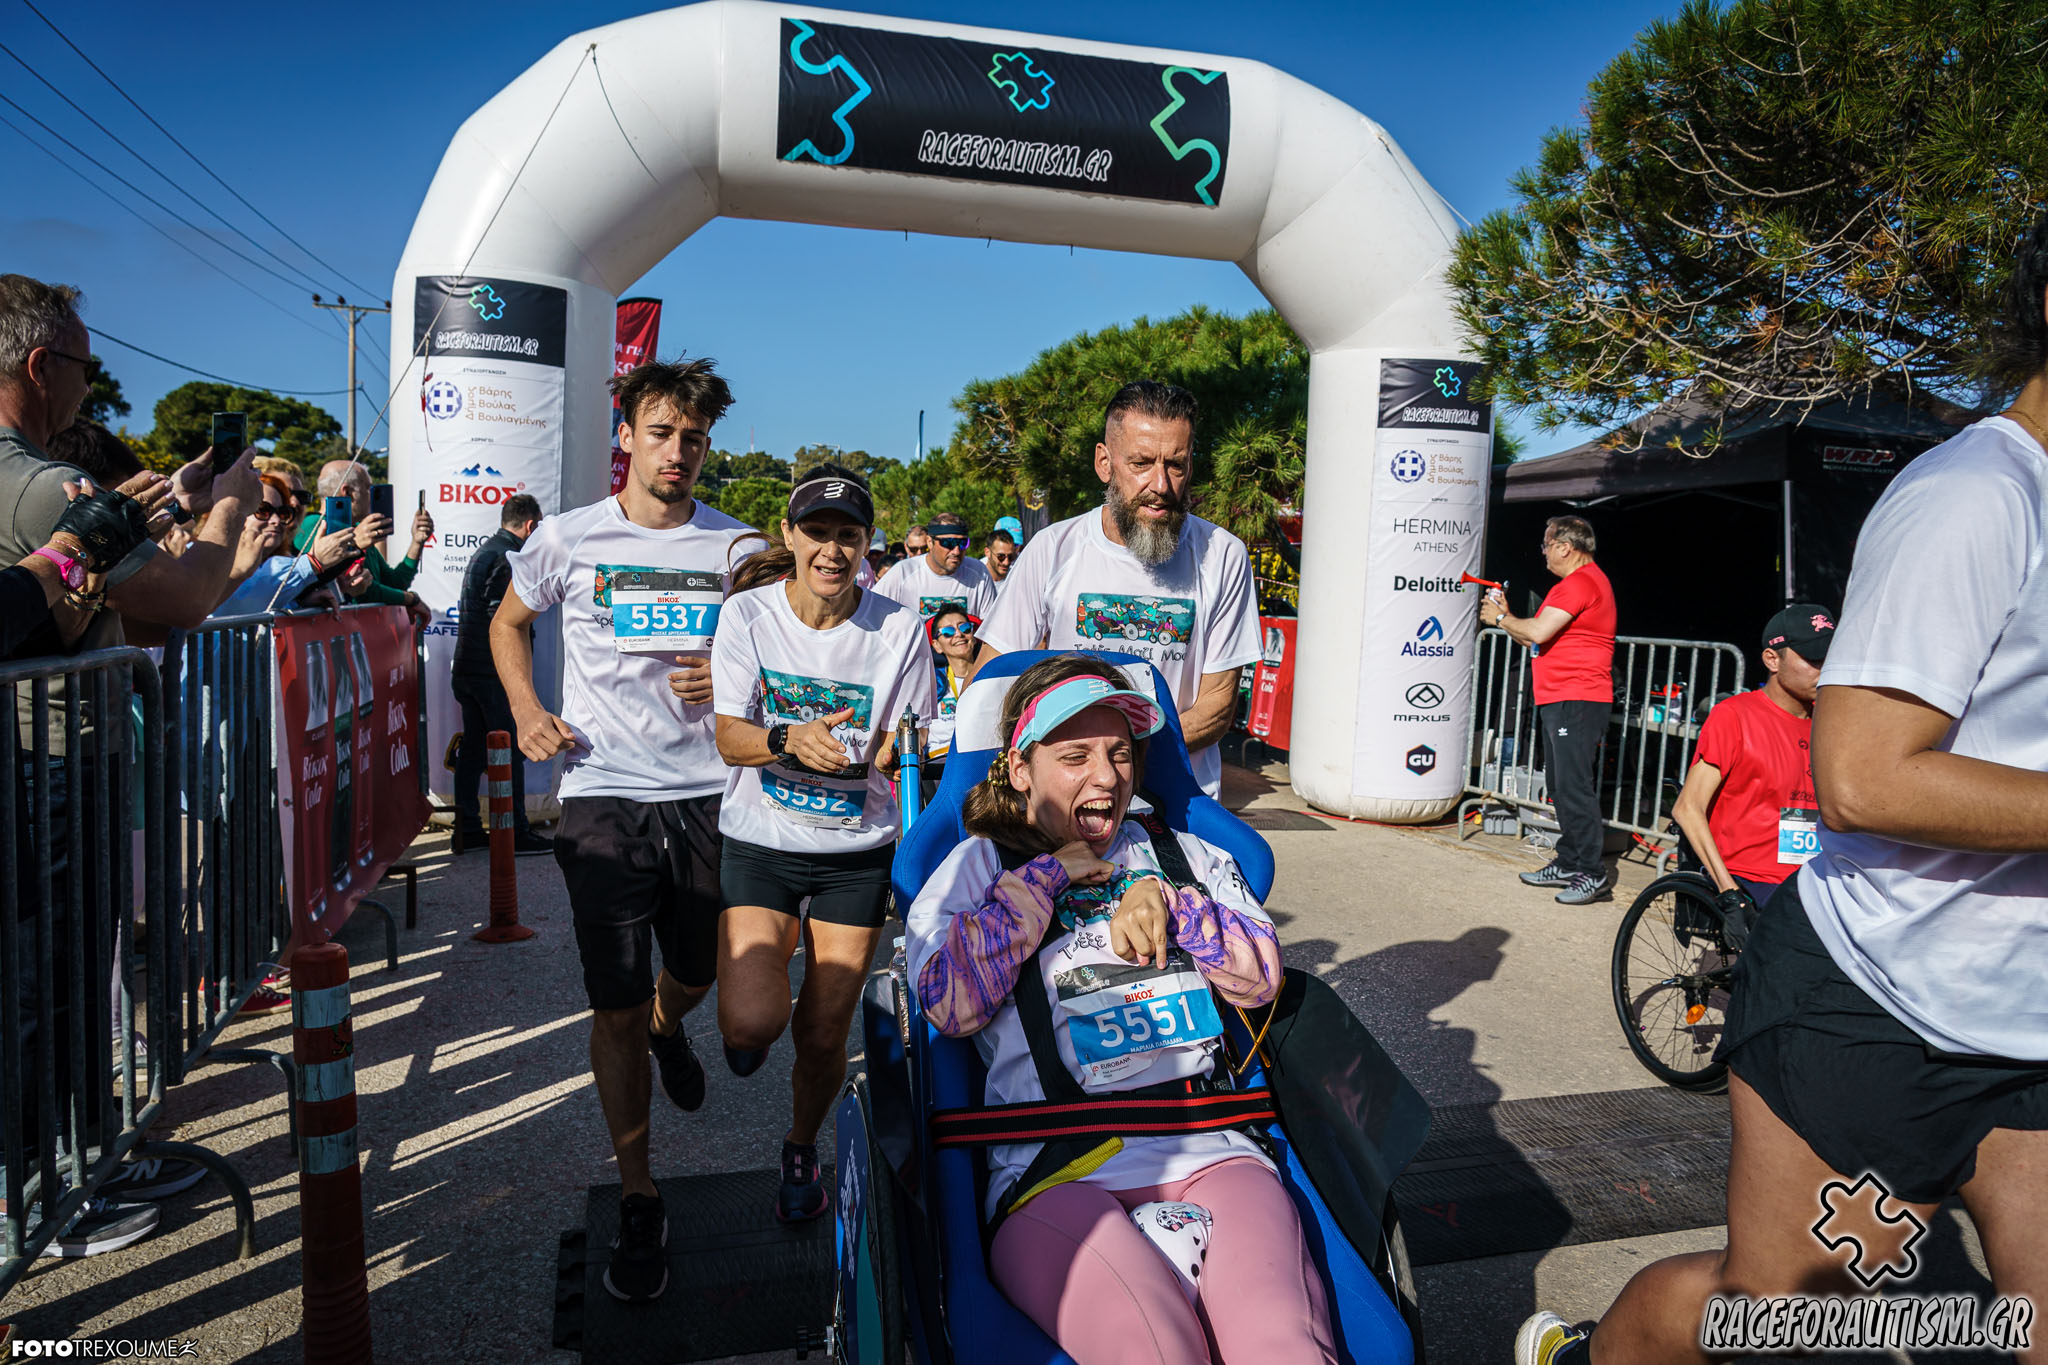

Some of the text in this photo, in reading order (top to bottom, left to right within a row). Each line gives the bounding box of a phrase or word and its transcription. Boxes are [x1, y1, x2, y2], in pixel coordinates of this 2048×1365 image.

[918, 129, 1113, 183] RACEFORAUTISM.GR
[435, 330, 540, 357] RACEFORAUTISM.GR
[479, 385, 513, 400] Βάρης
[478, 399, 517, 414] Βούλας
[477, 411, 547, 429] Βουλιαγμένης
[1823, 446, 1896, 465] WRP
[1394, 518, 1471, 535] HERMINA
[445, 534, 490, 548] EURO
[1413, 542, 1459, 553] ATHENS
[444, 554, 467, 562] Asset
[1394, 575, 1466, 593] Deloitte.
[592, 614, 614, 629] Τρέ
[631, 605, 708, 630] 5537
[1401, 641, 1454, 657] Alassia
[1394, 714, 1451, 722] MAXUS
[1408, 754, 1434, 767] GU
[775, 778, 849, 812] 5532
[1792, 832, 1823, 851] 50
[1124, 988, 1155, 1004] ΒΙΚΟΣ
[1094, 994, 1195, 1048] 5551
[1100, 1056, 1132, 1070] EUROBANK
